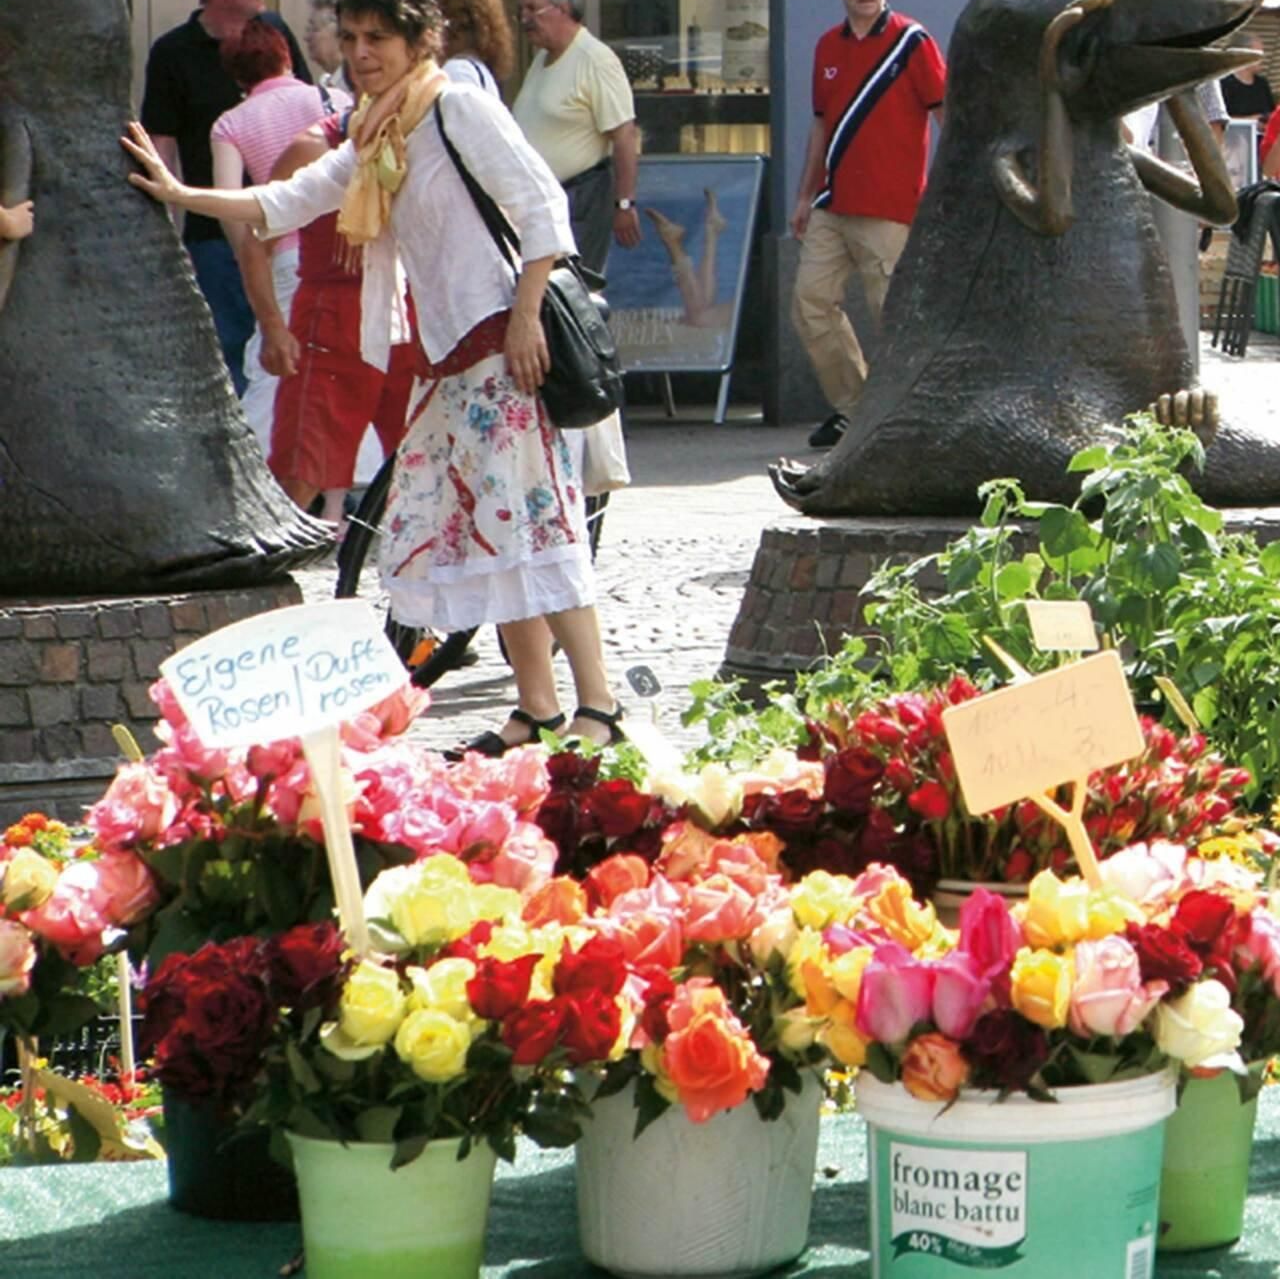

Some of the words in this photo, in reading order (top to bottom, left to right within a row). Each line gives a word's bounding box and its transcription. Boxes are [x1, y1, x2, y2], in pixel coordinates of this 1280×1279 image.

[175, 634, 300, 697] Eigene
[197, 688, 291, 735] Rosen
[319, 671, 391, 713] rosen
[893, 1153, 1022, 1200] fromage
[893, 1188, 947, 1219] blanc
[954, 1190, 1021, 1224] battu
[908, 1231, 942, 1255] 40%
